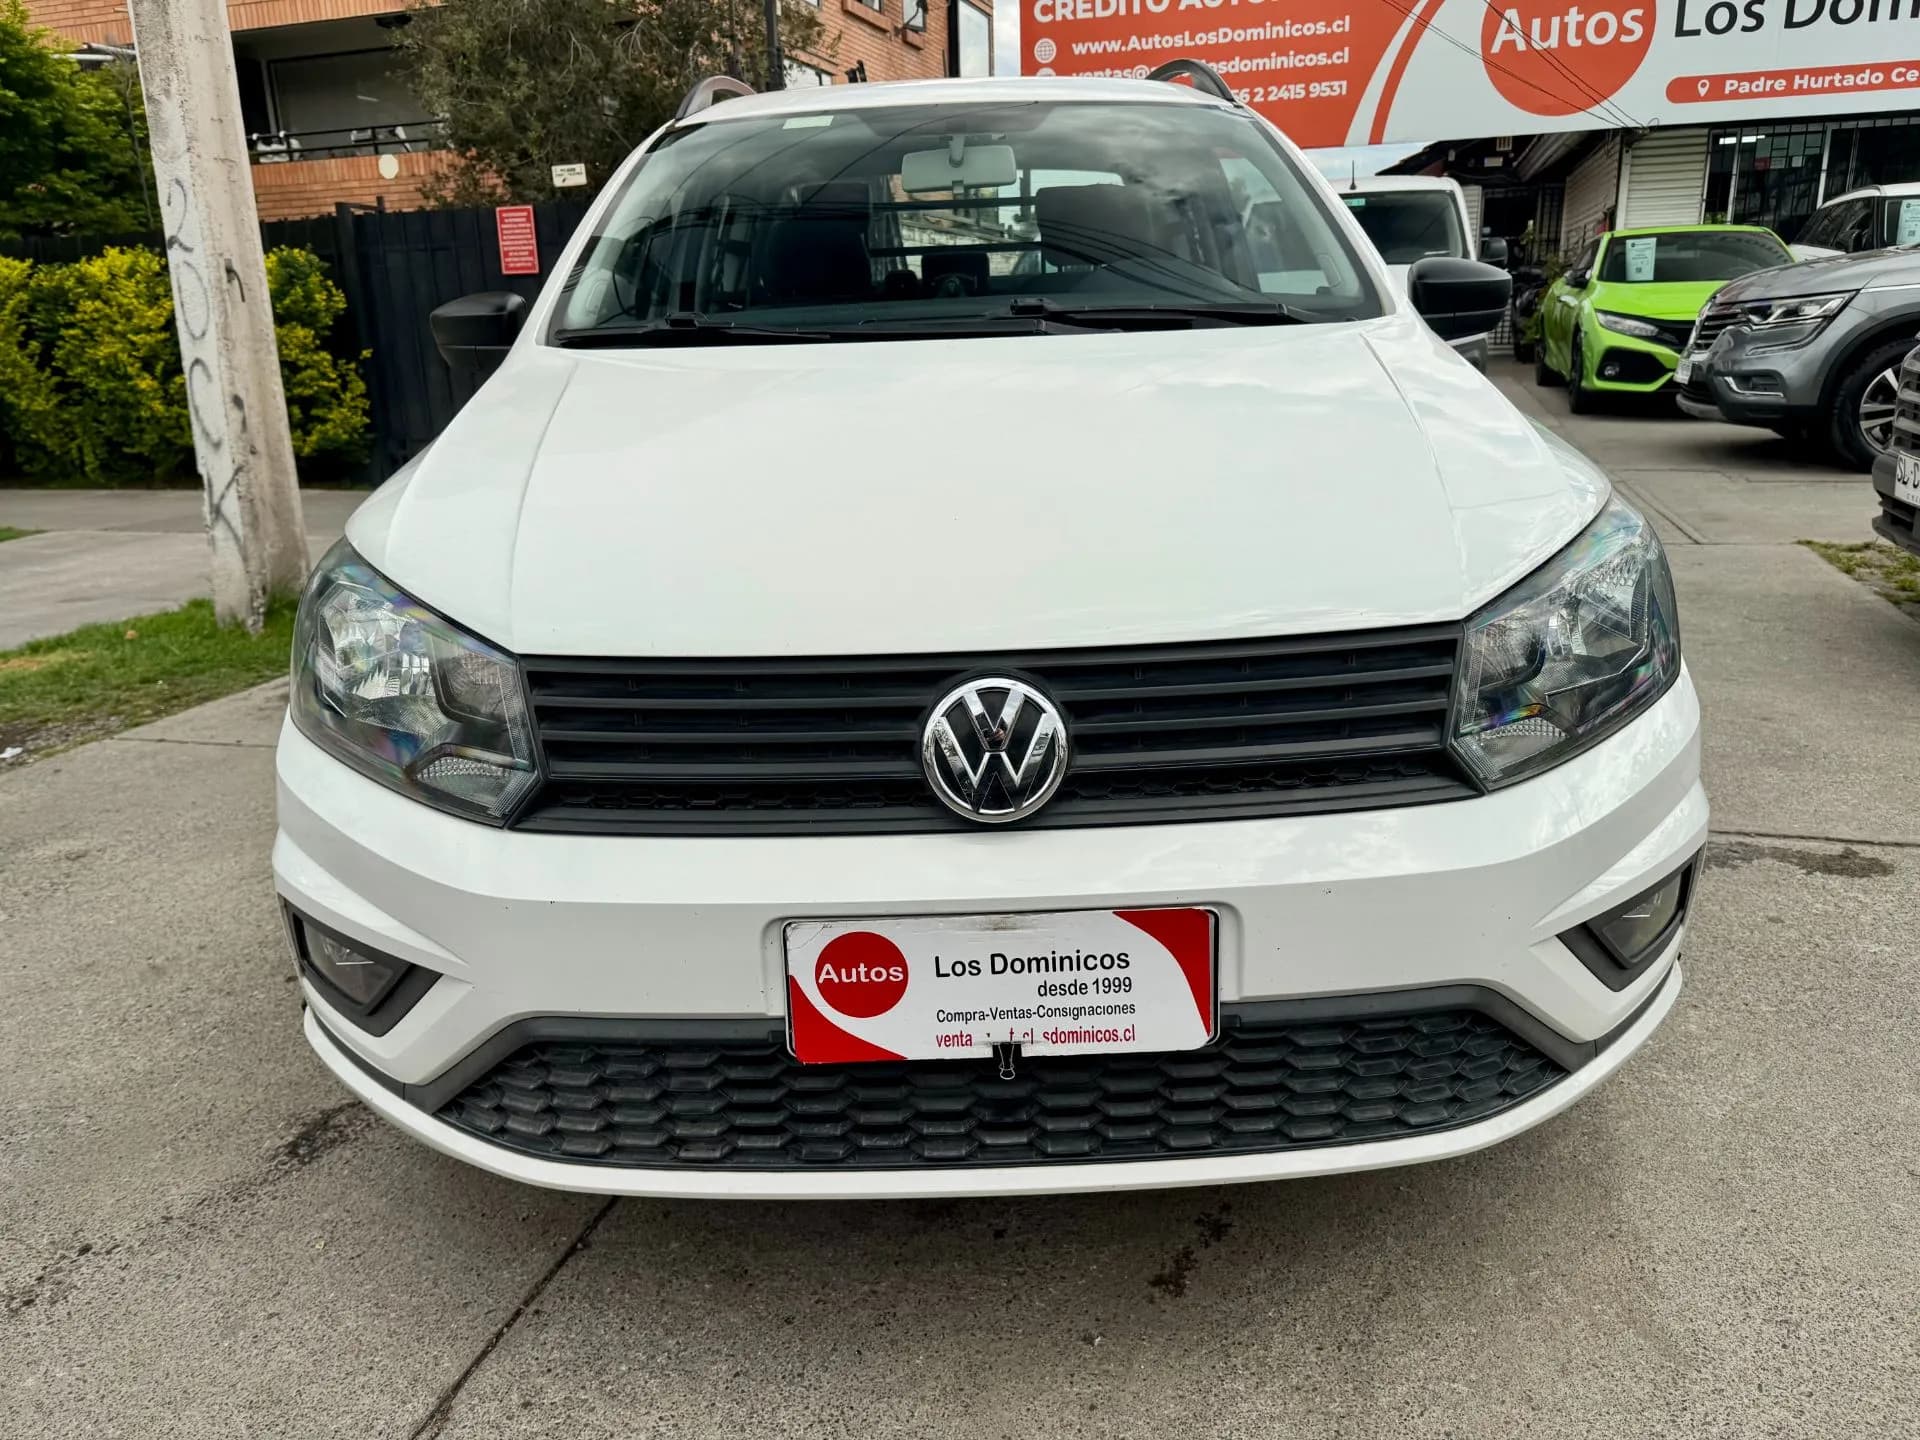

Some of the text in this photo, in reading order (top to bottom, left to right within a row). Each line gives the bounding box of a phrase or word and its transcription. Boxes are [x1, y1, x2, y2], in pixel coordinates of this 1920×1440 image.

[1490, 6, 1644, 54] Autos
[1674, 0, 1765, 38] Los
[1072, 15, 1350, 55] www.AutosLosDominicos.cl
[1253, 87, 1265, 102] 2
[1268, 83, 1306, 100] 2415
[1309, 80, 1347, 98] 9531
[1724, 76, 1787, 95] Padre
[1793, 69, 1884, 90] Hurtado
[818, 962, 904, 984] Autos
[934, 949, 1131, 978] Los Dominicos
[1037, 976, 1133, 997] desde 1999
